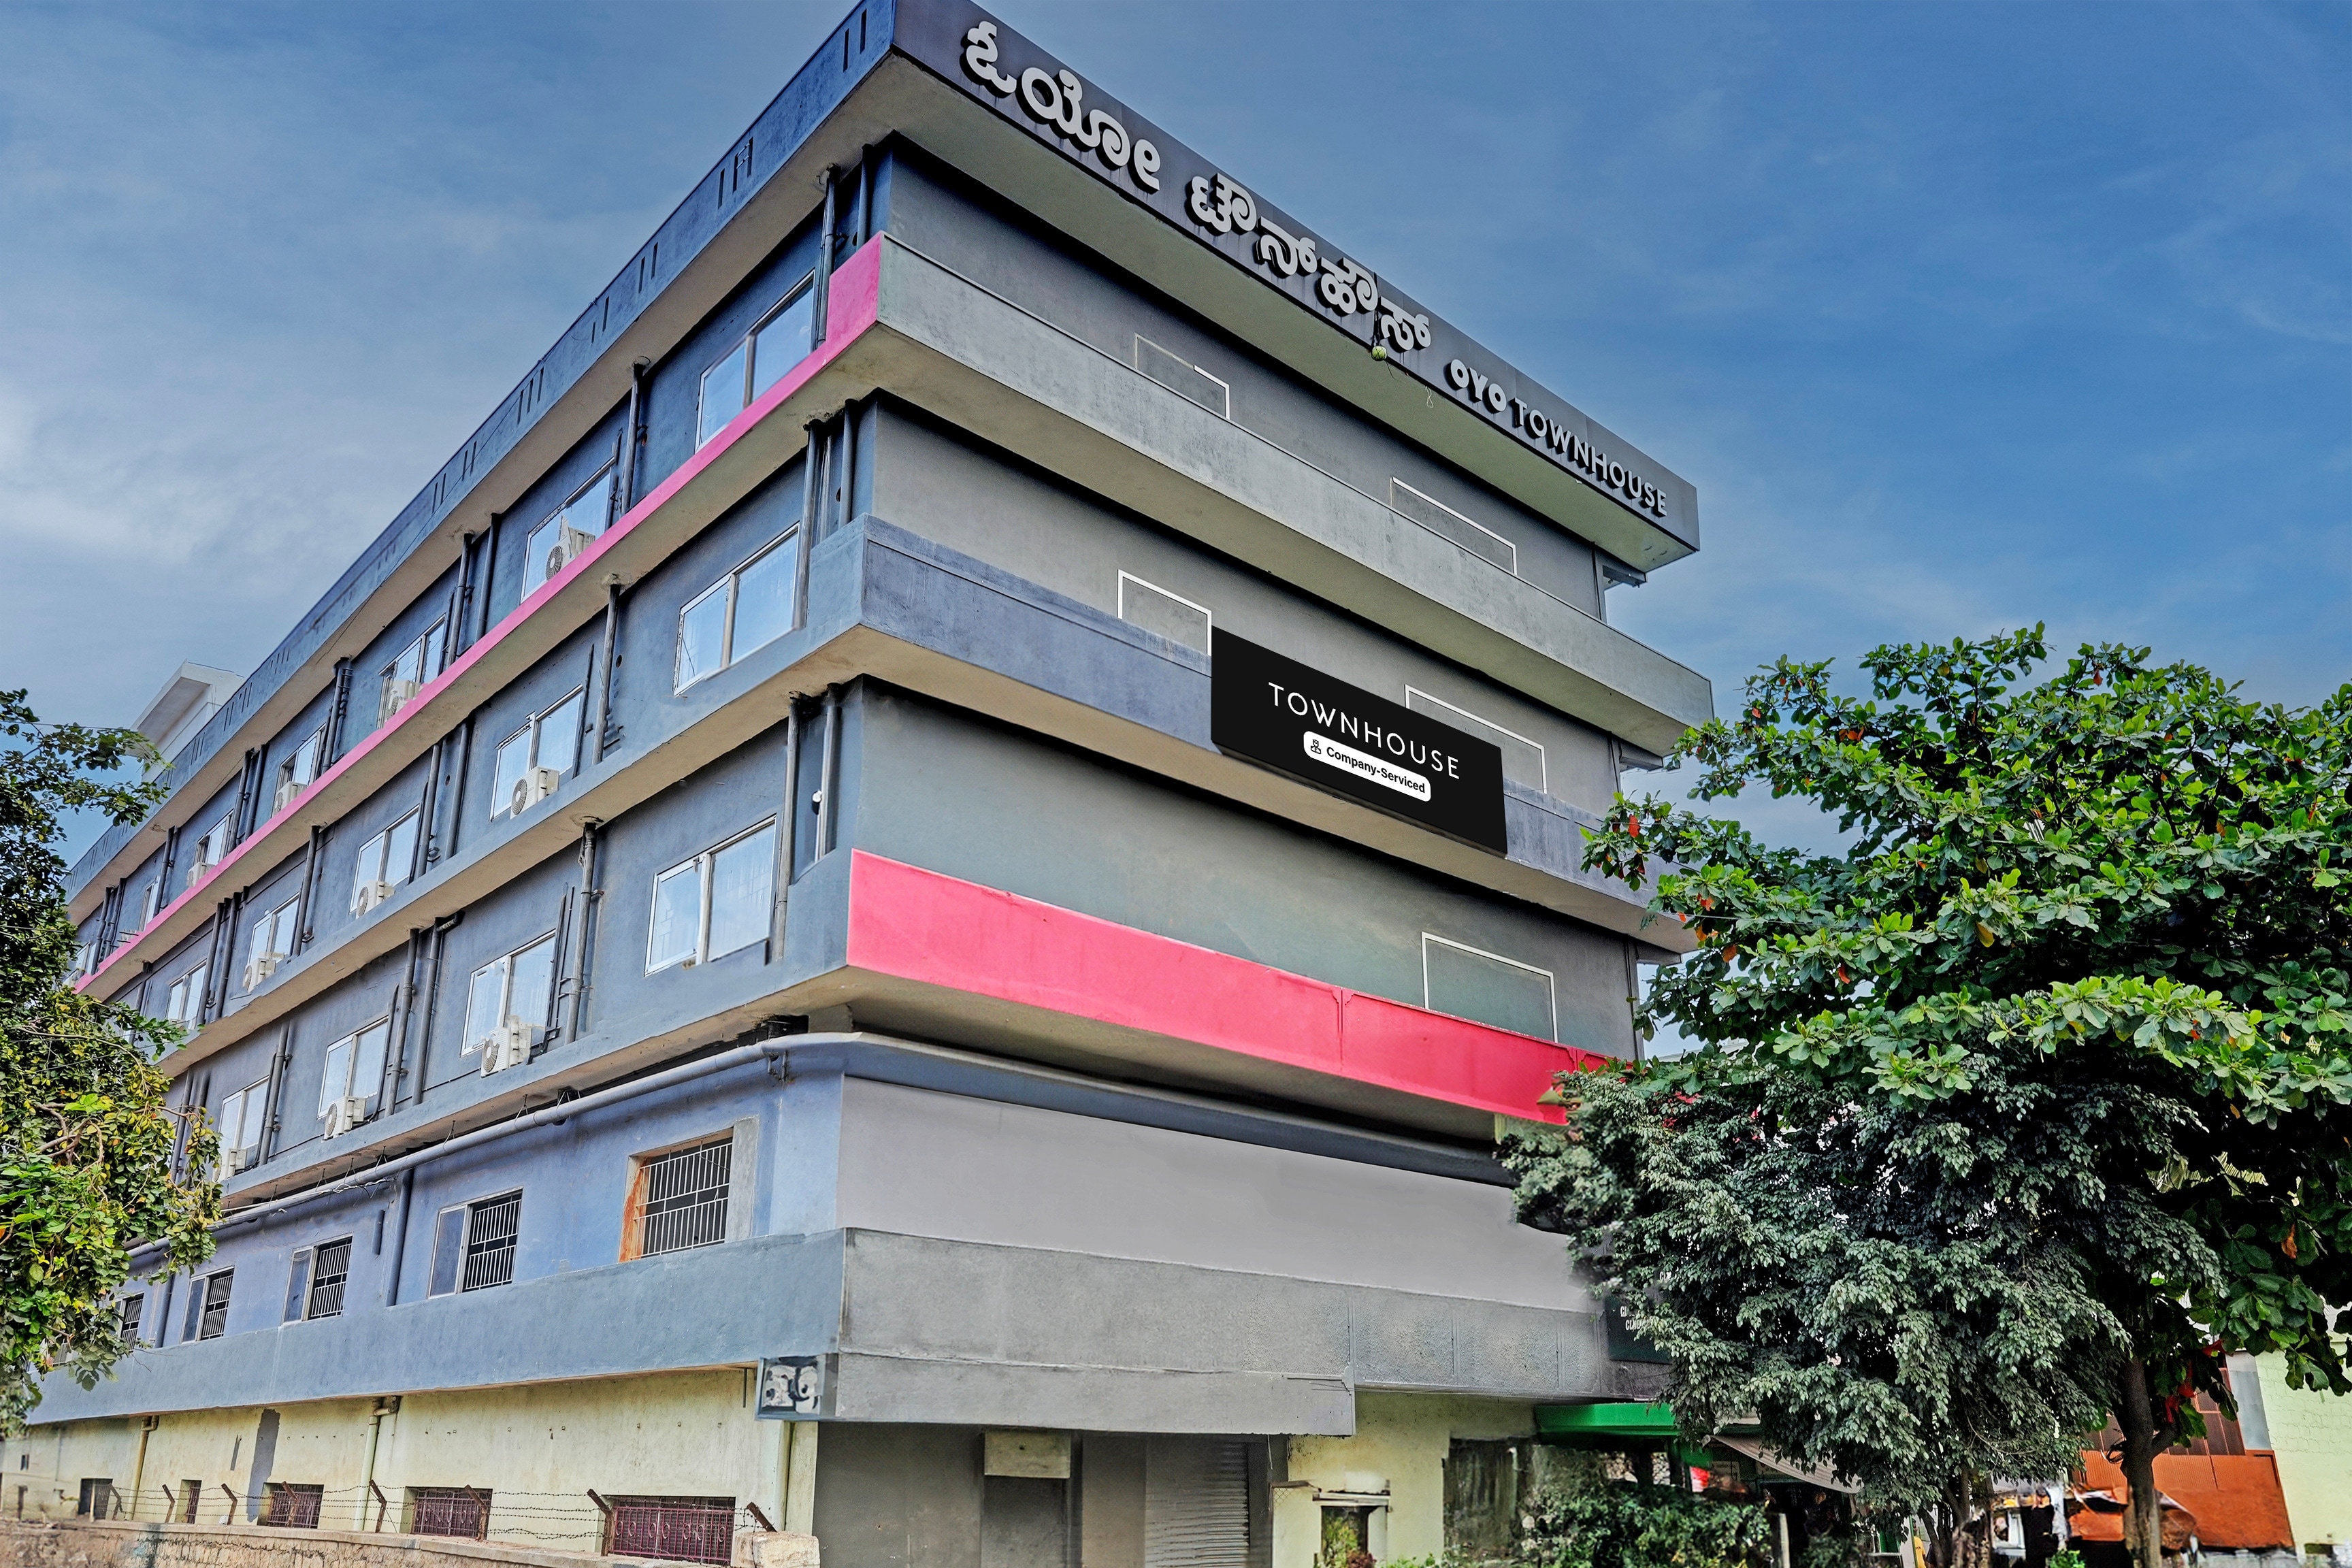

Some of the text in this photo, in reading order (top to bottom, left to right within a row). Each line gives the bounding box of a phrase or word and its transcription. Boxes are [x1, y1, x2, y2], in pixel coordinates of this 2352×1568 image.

[1450, 359, 1667, 517] OYO TOWNHOUSE
[1268, 682, 1460, 780] TOWNHOUSE
[1326, 747, 1426, 794] Company-Serviced
